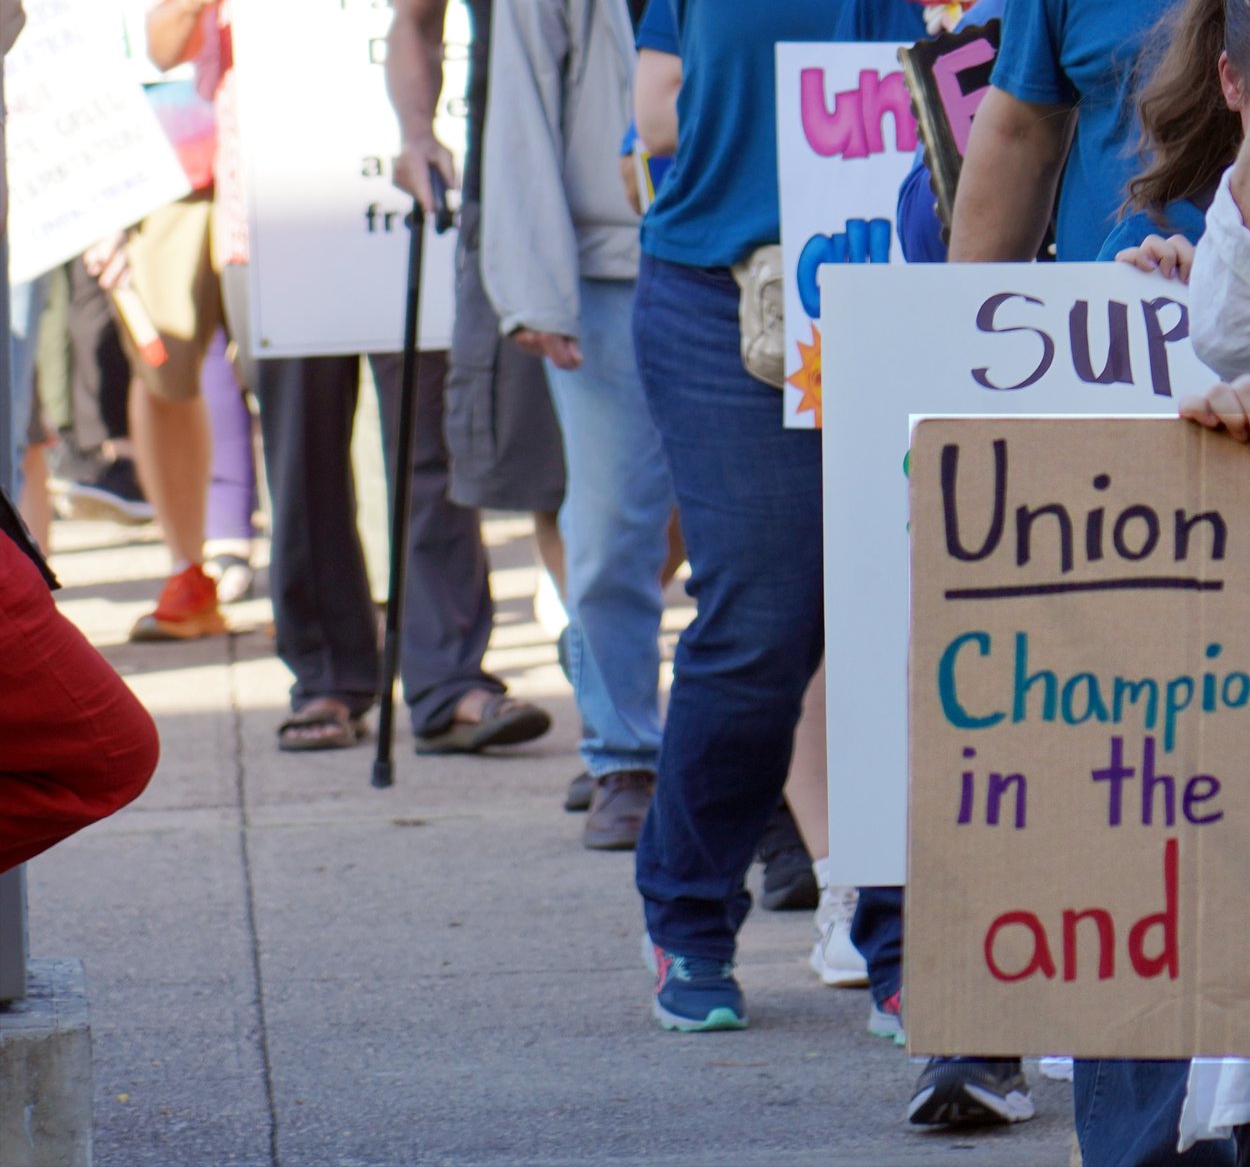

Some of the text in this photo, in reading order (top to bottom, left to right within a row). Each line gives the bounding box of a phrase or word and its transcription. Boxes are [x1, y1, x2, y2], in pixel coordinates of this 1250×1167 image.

[940, 440, 1228, 573] Union
[956, 747, 1028, 830] in
[1091, 735, 1225, 827] the
[984, 838, 1179, 983] and
